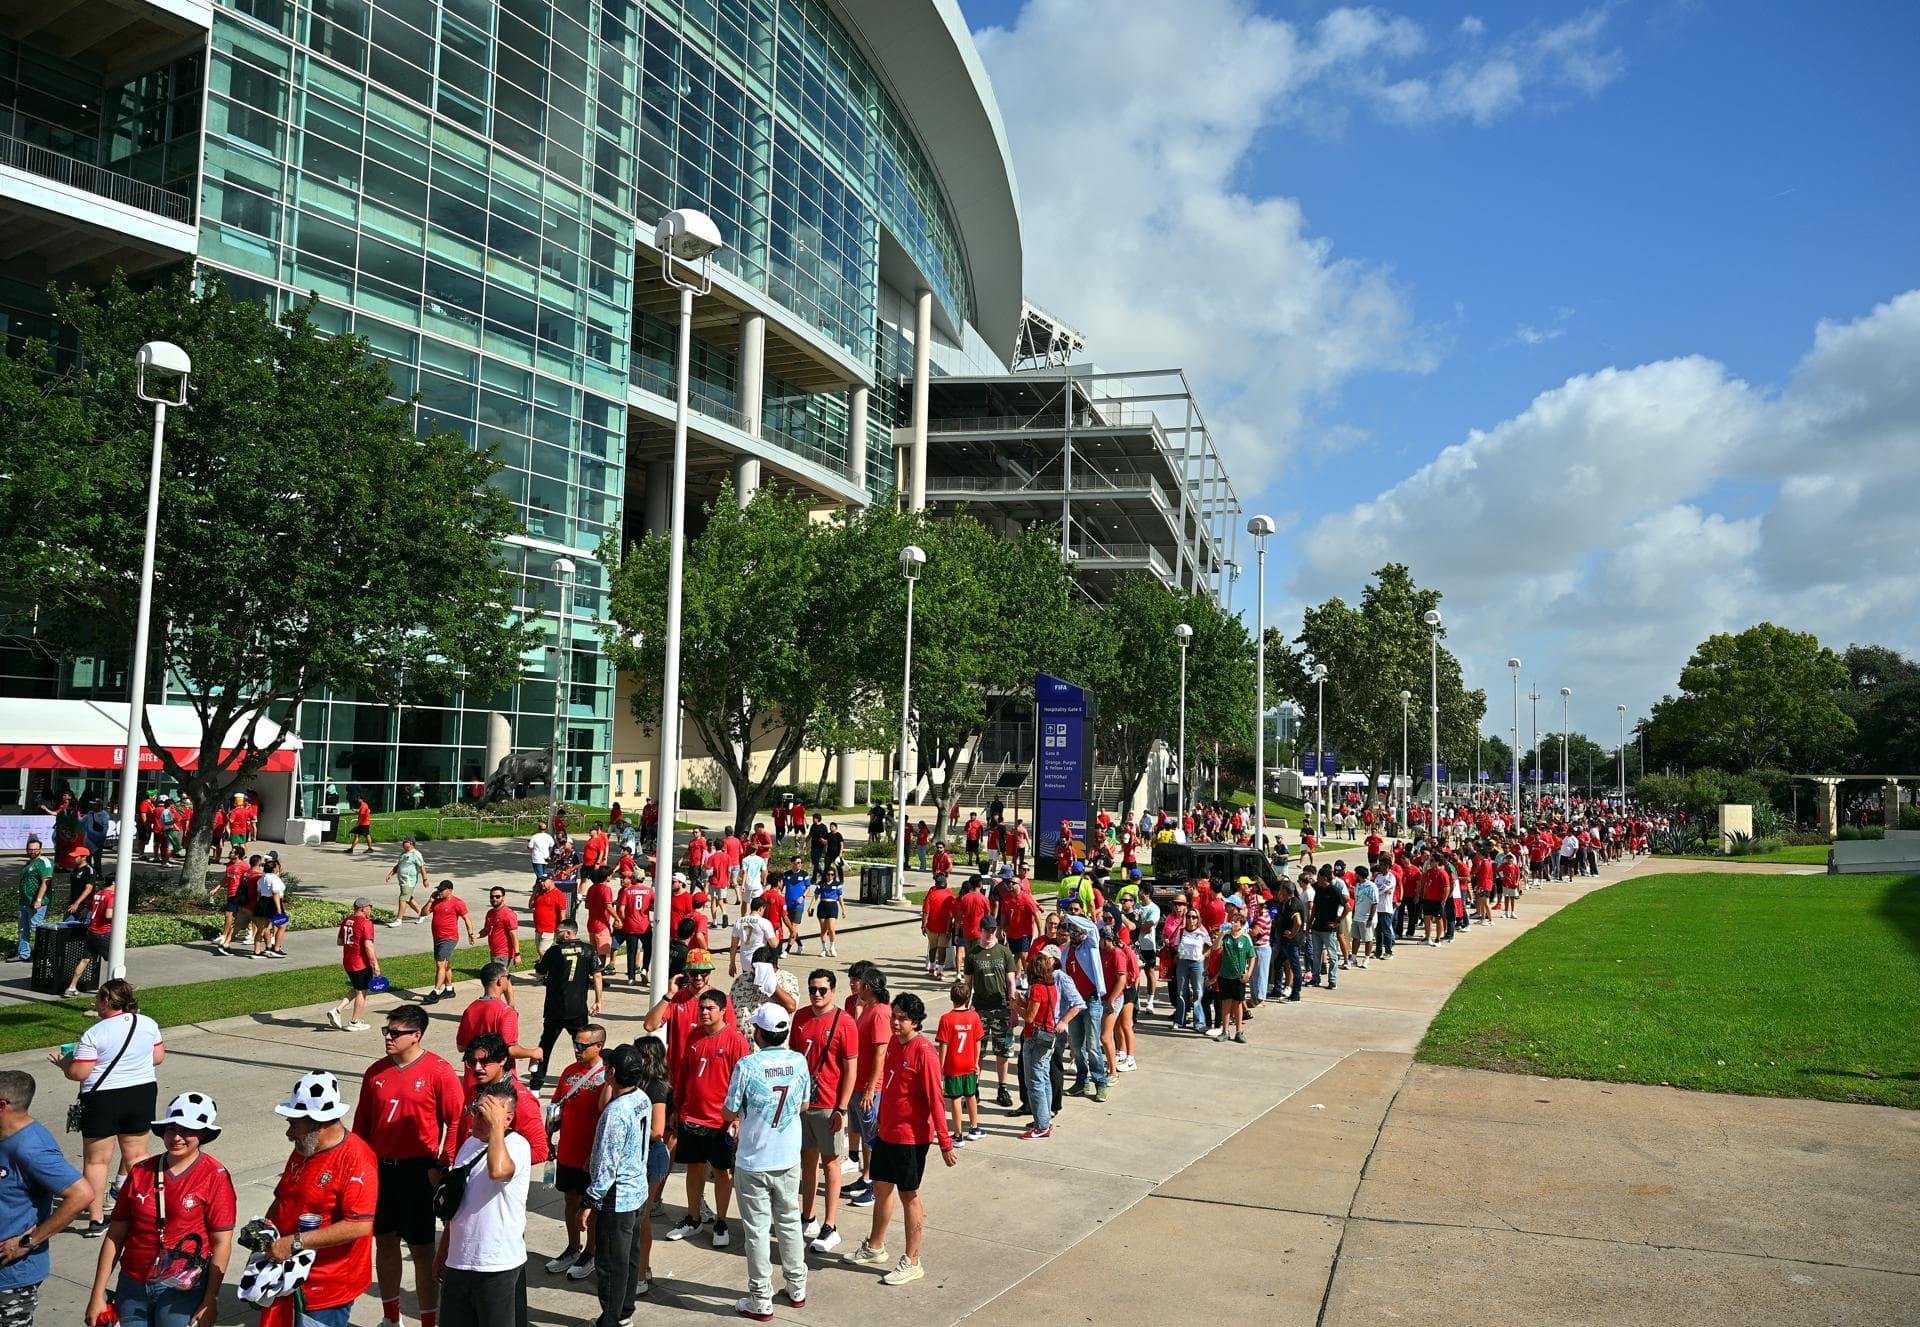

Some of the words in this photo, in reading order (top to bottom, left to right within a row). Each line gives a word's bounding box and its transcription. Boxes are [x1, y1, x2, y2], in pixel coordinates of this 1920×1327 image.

[635, 894, 643, 910] 8
[343, 926, 355, 945] 12
[743, 925, 753, 945] 7
[566, 955, 578, 982] 7
[957, 1031, 968, 1054] 7
[698, 1057, 708, 1078] 7
[764, 1065, 794, 1079] RONALDO
[885, 1069, 895, 1089] 7
[387, 1098, 400, 1123] 7
[770, 1085, 790, 1129] 7
